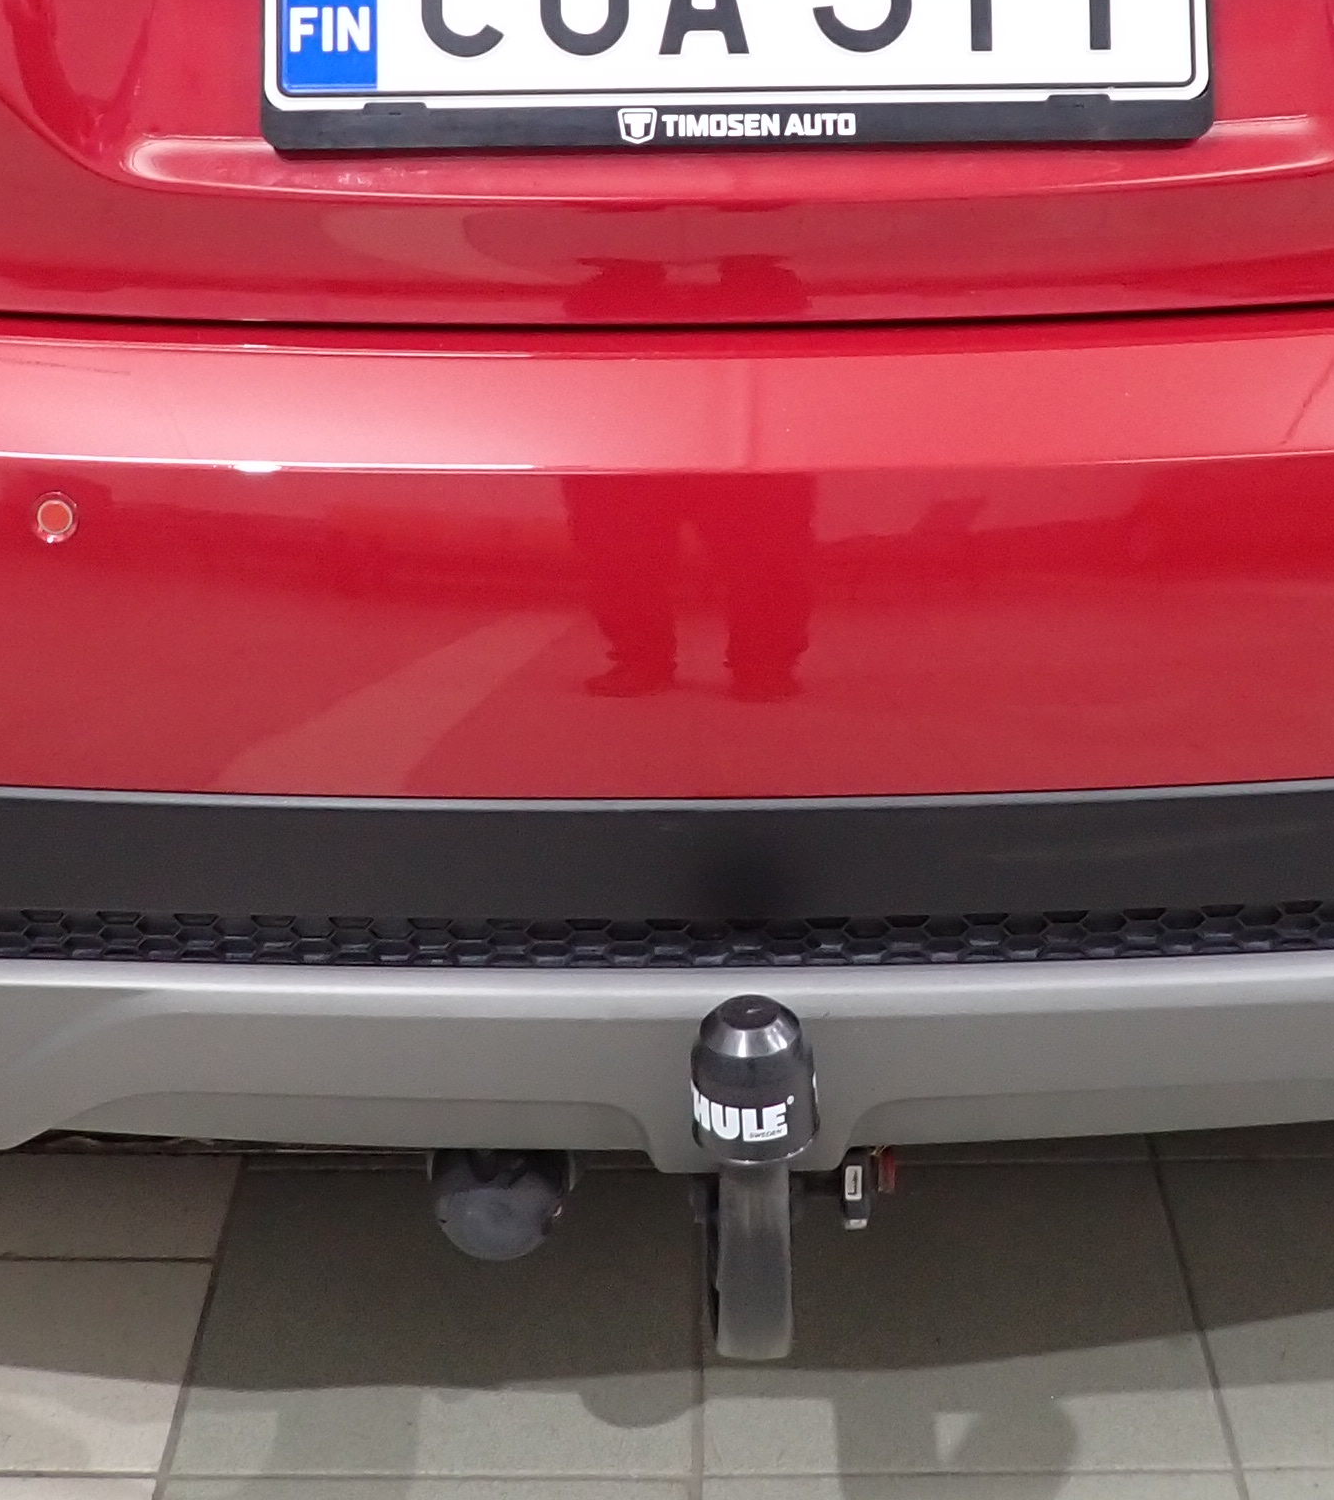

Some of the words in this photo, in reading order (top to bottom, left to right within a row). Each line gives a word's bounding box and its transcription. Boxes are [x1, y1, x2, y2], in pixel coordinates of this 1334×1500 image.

[289, 7, 371, 53] FIN
[661, 114, 780, 137] TIMOSEN
[784, 113, 856, 136] AUTO
[690, 1079, 788, 1142] HULE
